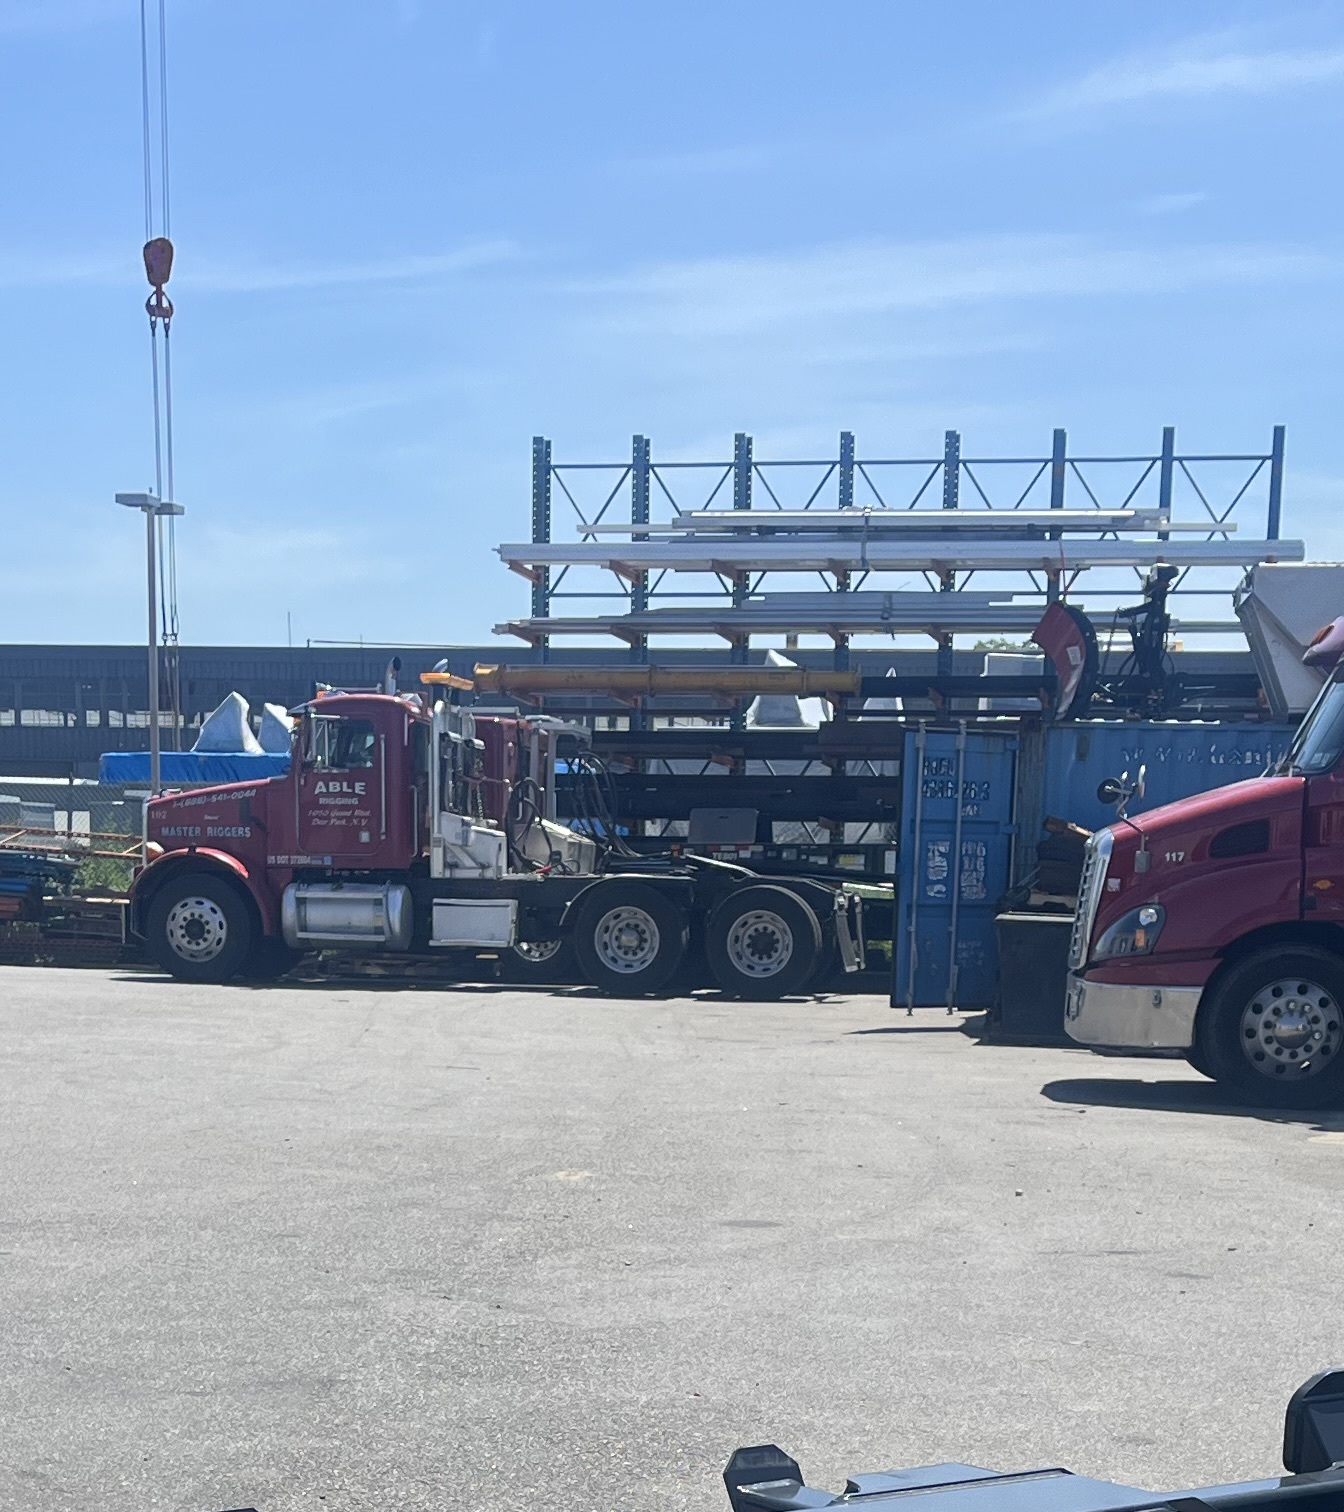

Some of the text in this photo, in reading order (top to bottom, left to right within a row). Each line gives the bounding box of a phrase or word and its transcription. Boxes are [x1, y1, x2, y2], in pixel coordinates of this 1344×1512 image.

[314, 781, 367, 795] ABLE
[319, 797, 359, 805] RIGGING
[161, 826, 252, 838] MASTER RIGGERS
[1165, 851, 1185, 862] 117
